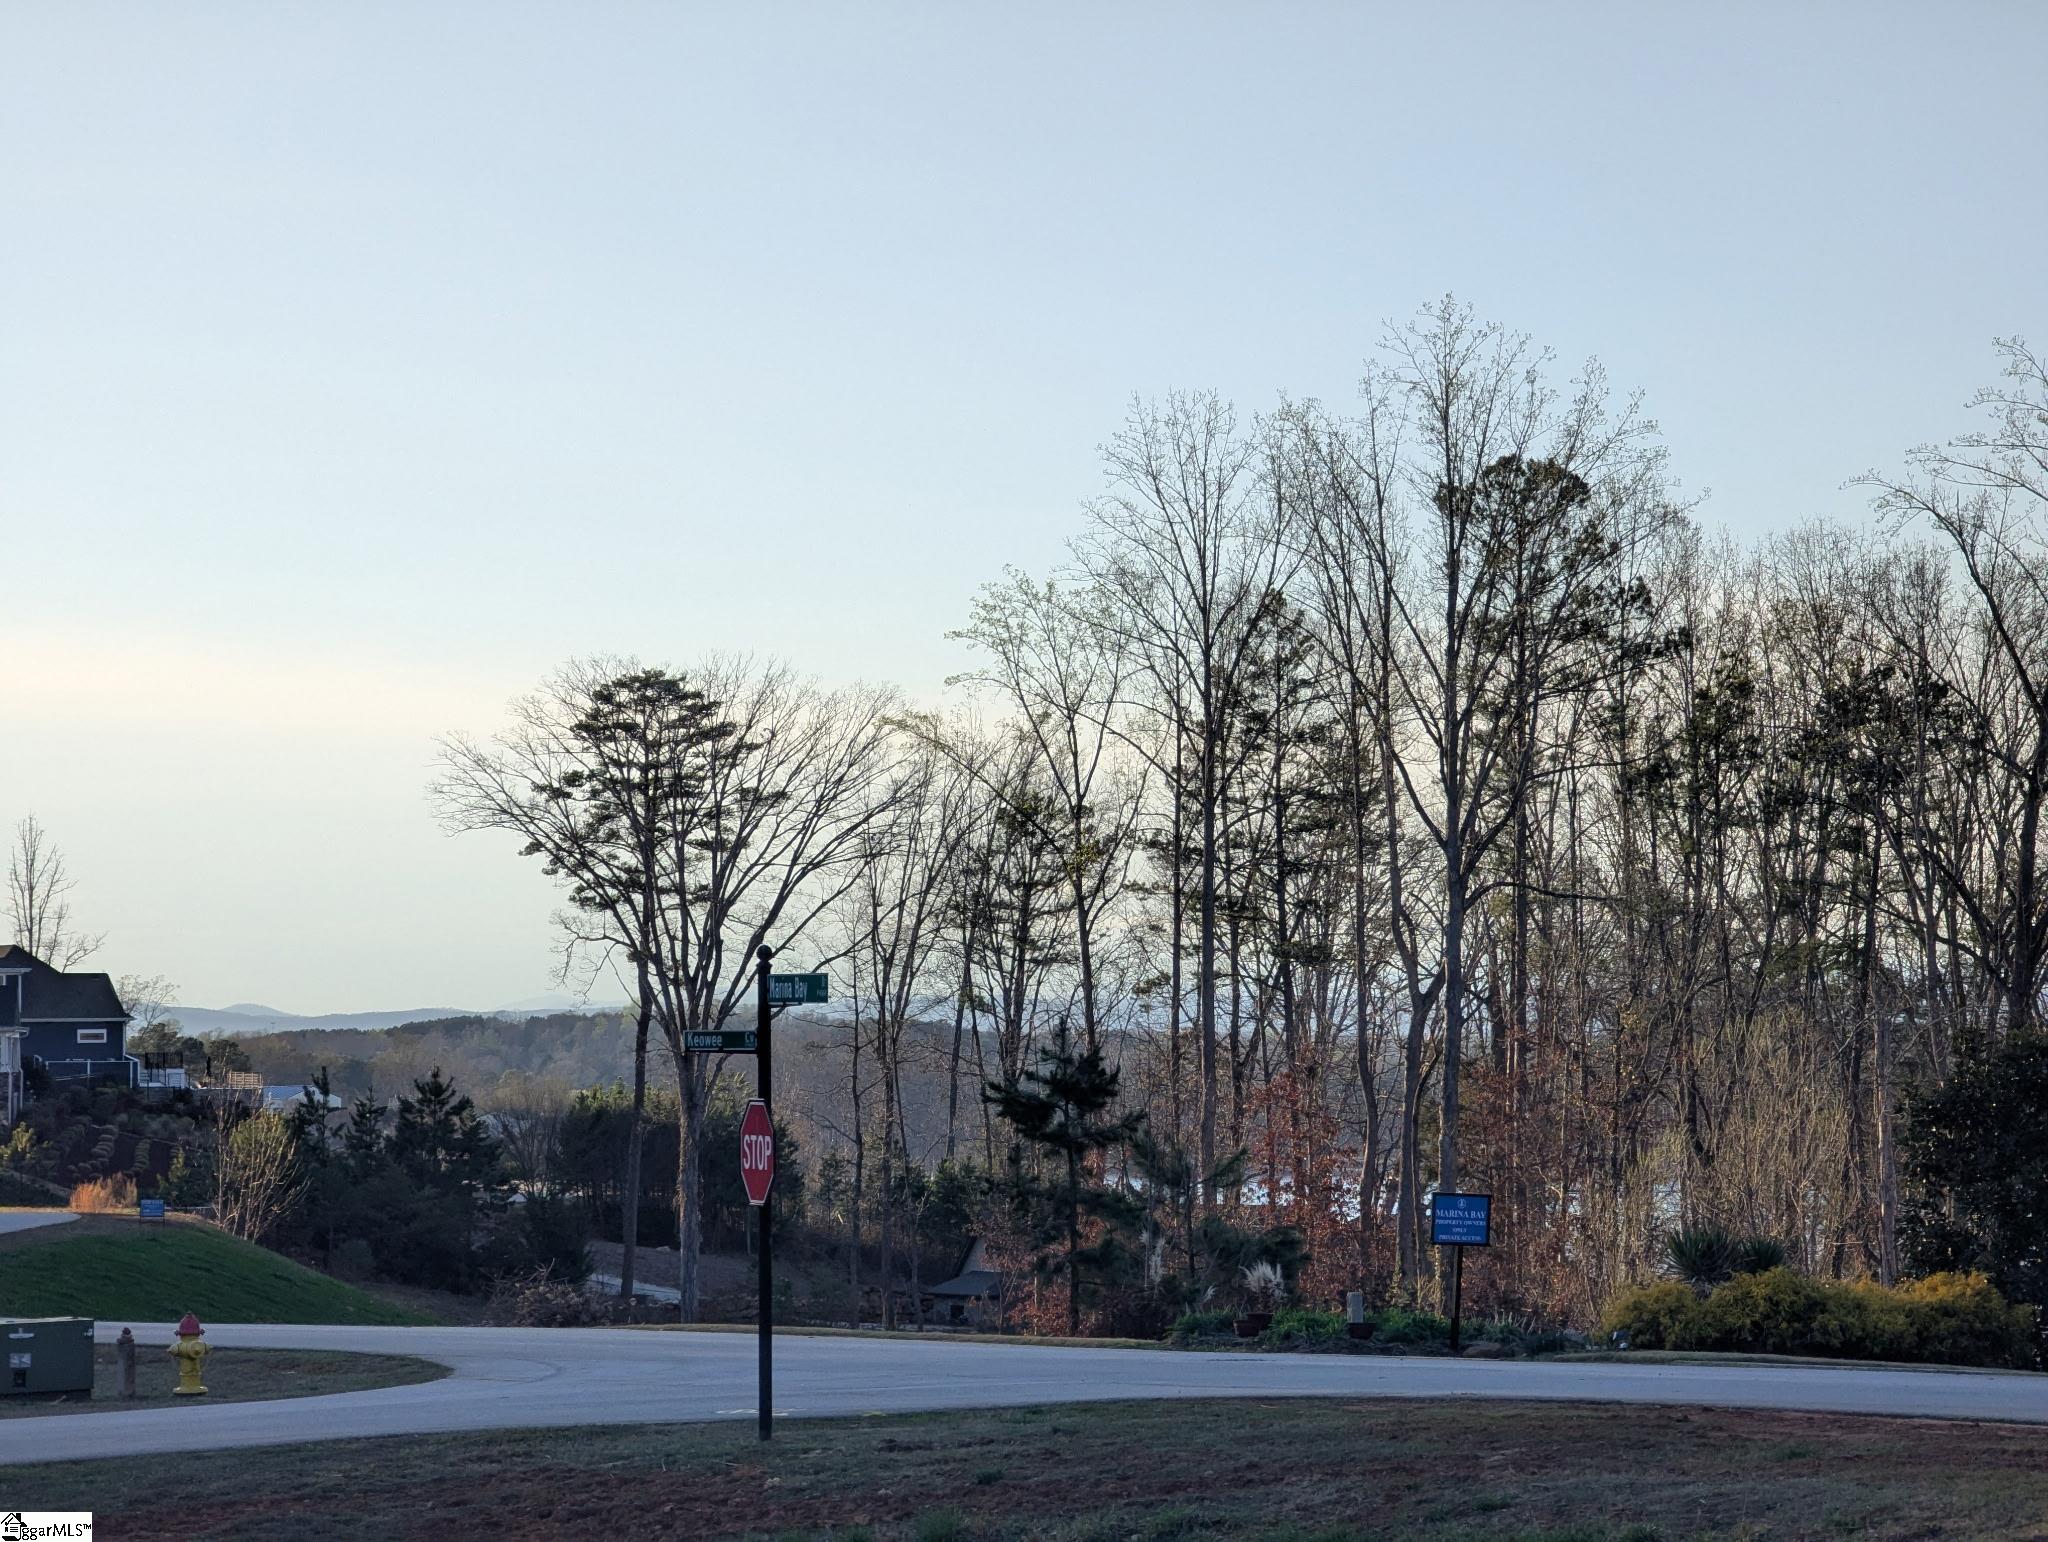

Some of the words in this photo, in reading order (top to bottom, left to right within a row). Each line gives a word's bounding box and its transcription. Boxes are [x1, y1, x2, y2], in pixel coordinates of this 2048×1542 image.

[770, 976, 792, 998] Marina
[795, 976, 808, 1001] Bay
[687, 1032, 723, 1047] Keowee
[743, 1134, 772, 1170] STOP
[1435, 1209, 1469, 1218] MARINA
[1470, 1210, 1487, 1219] BAY
